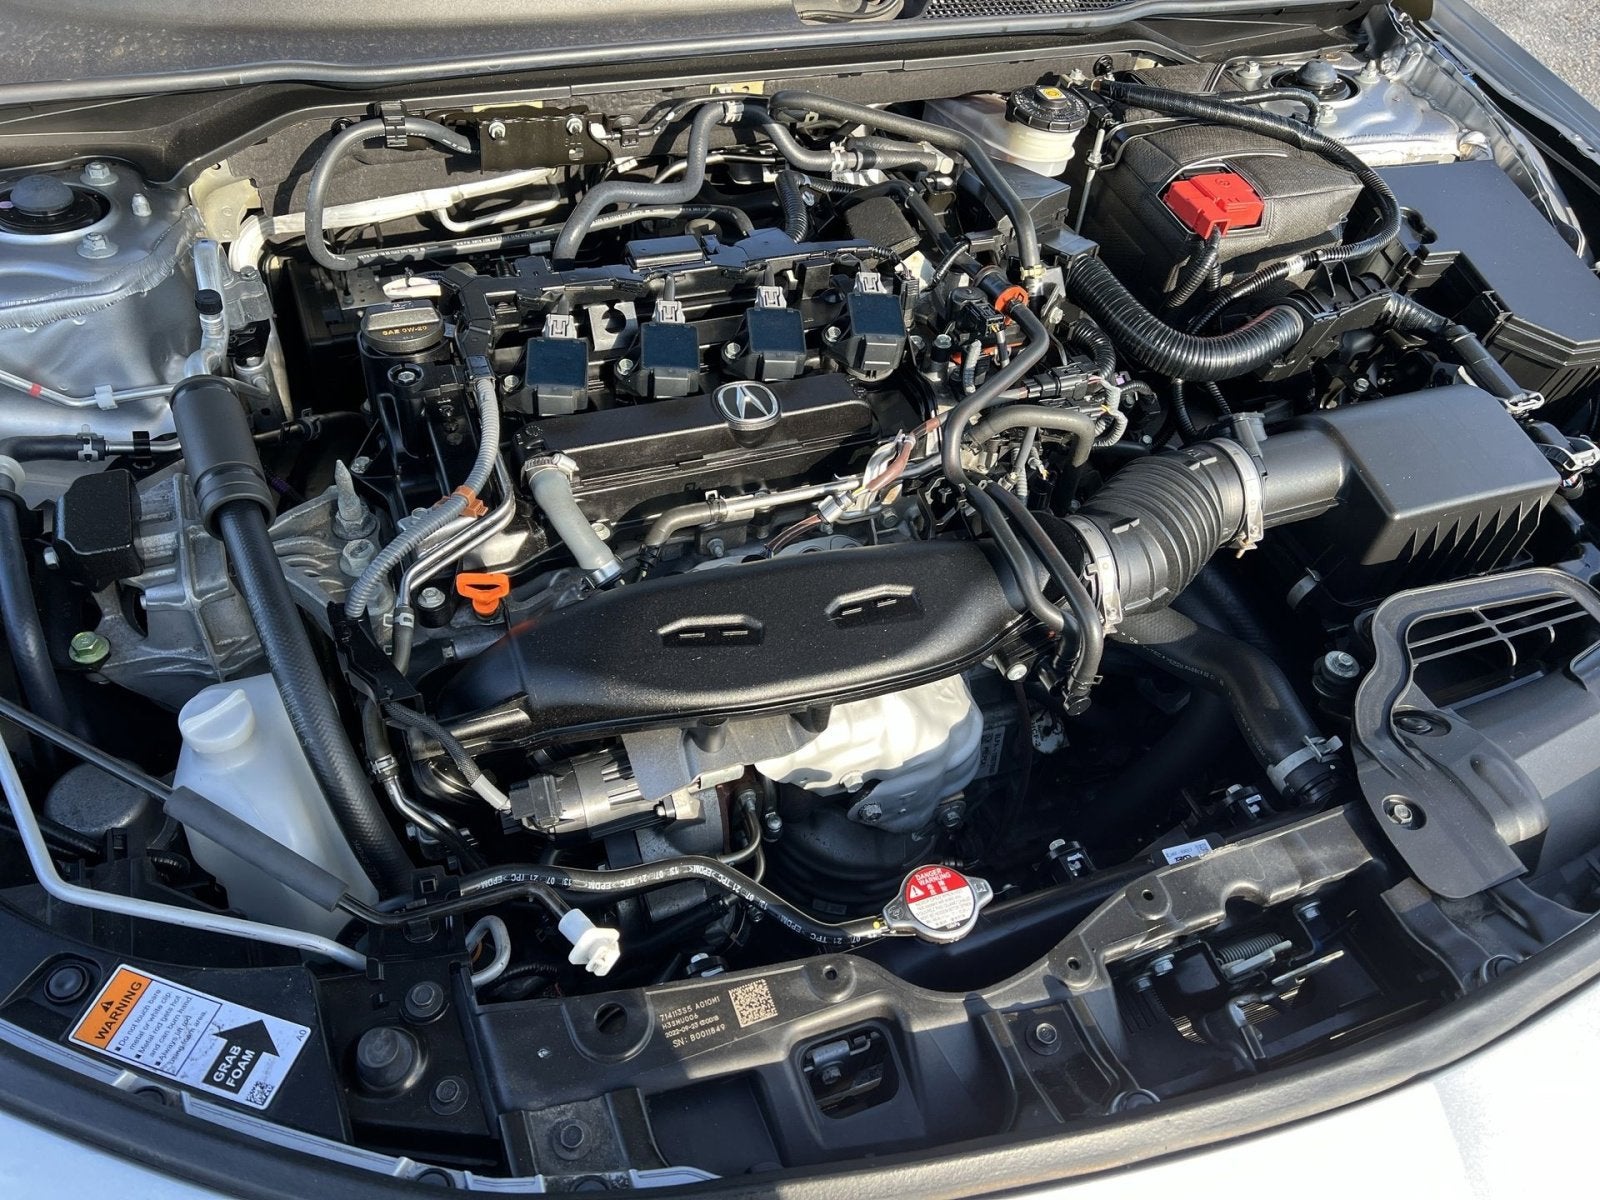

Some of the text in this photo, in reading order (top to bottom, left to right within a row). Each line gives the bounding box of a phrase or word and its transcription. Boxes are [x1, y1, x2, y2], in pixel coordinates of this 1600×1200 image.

[716, 873, 732, 888] TPC
[914, 867, 942, 880] DANGER
[809, 933, 828, 944] TPC
[94, 980, 143, 1040] WARNING
[118, 988, 161, 1046] Do not touch bare
[127, 1030, 144, 1050] metal
[141, 1022, 150, 1030] or
[146, 1004, 163, 1022] white
[137, 994, 181, 1054] Metal rod gets hot
[147, 1043, 161, 1057] and
[158, 1030, 170, 1043] can
[166, 1013, 181, 1029] burn
[157, 1036, 178, 1061] Always
[665, 1022, 698, 1038] 2022-09-23
[672, 1024, 726, 1048] SN: B0011849
[211, 1044, 242, 1082] GRAB
[224, 1048, 256, 1087] FOAM
